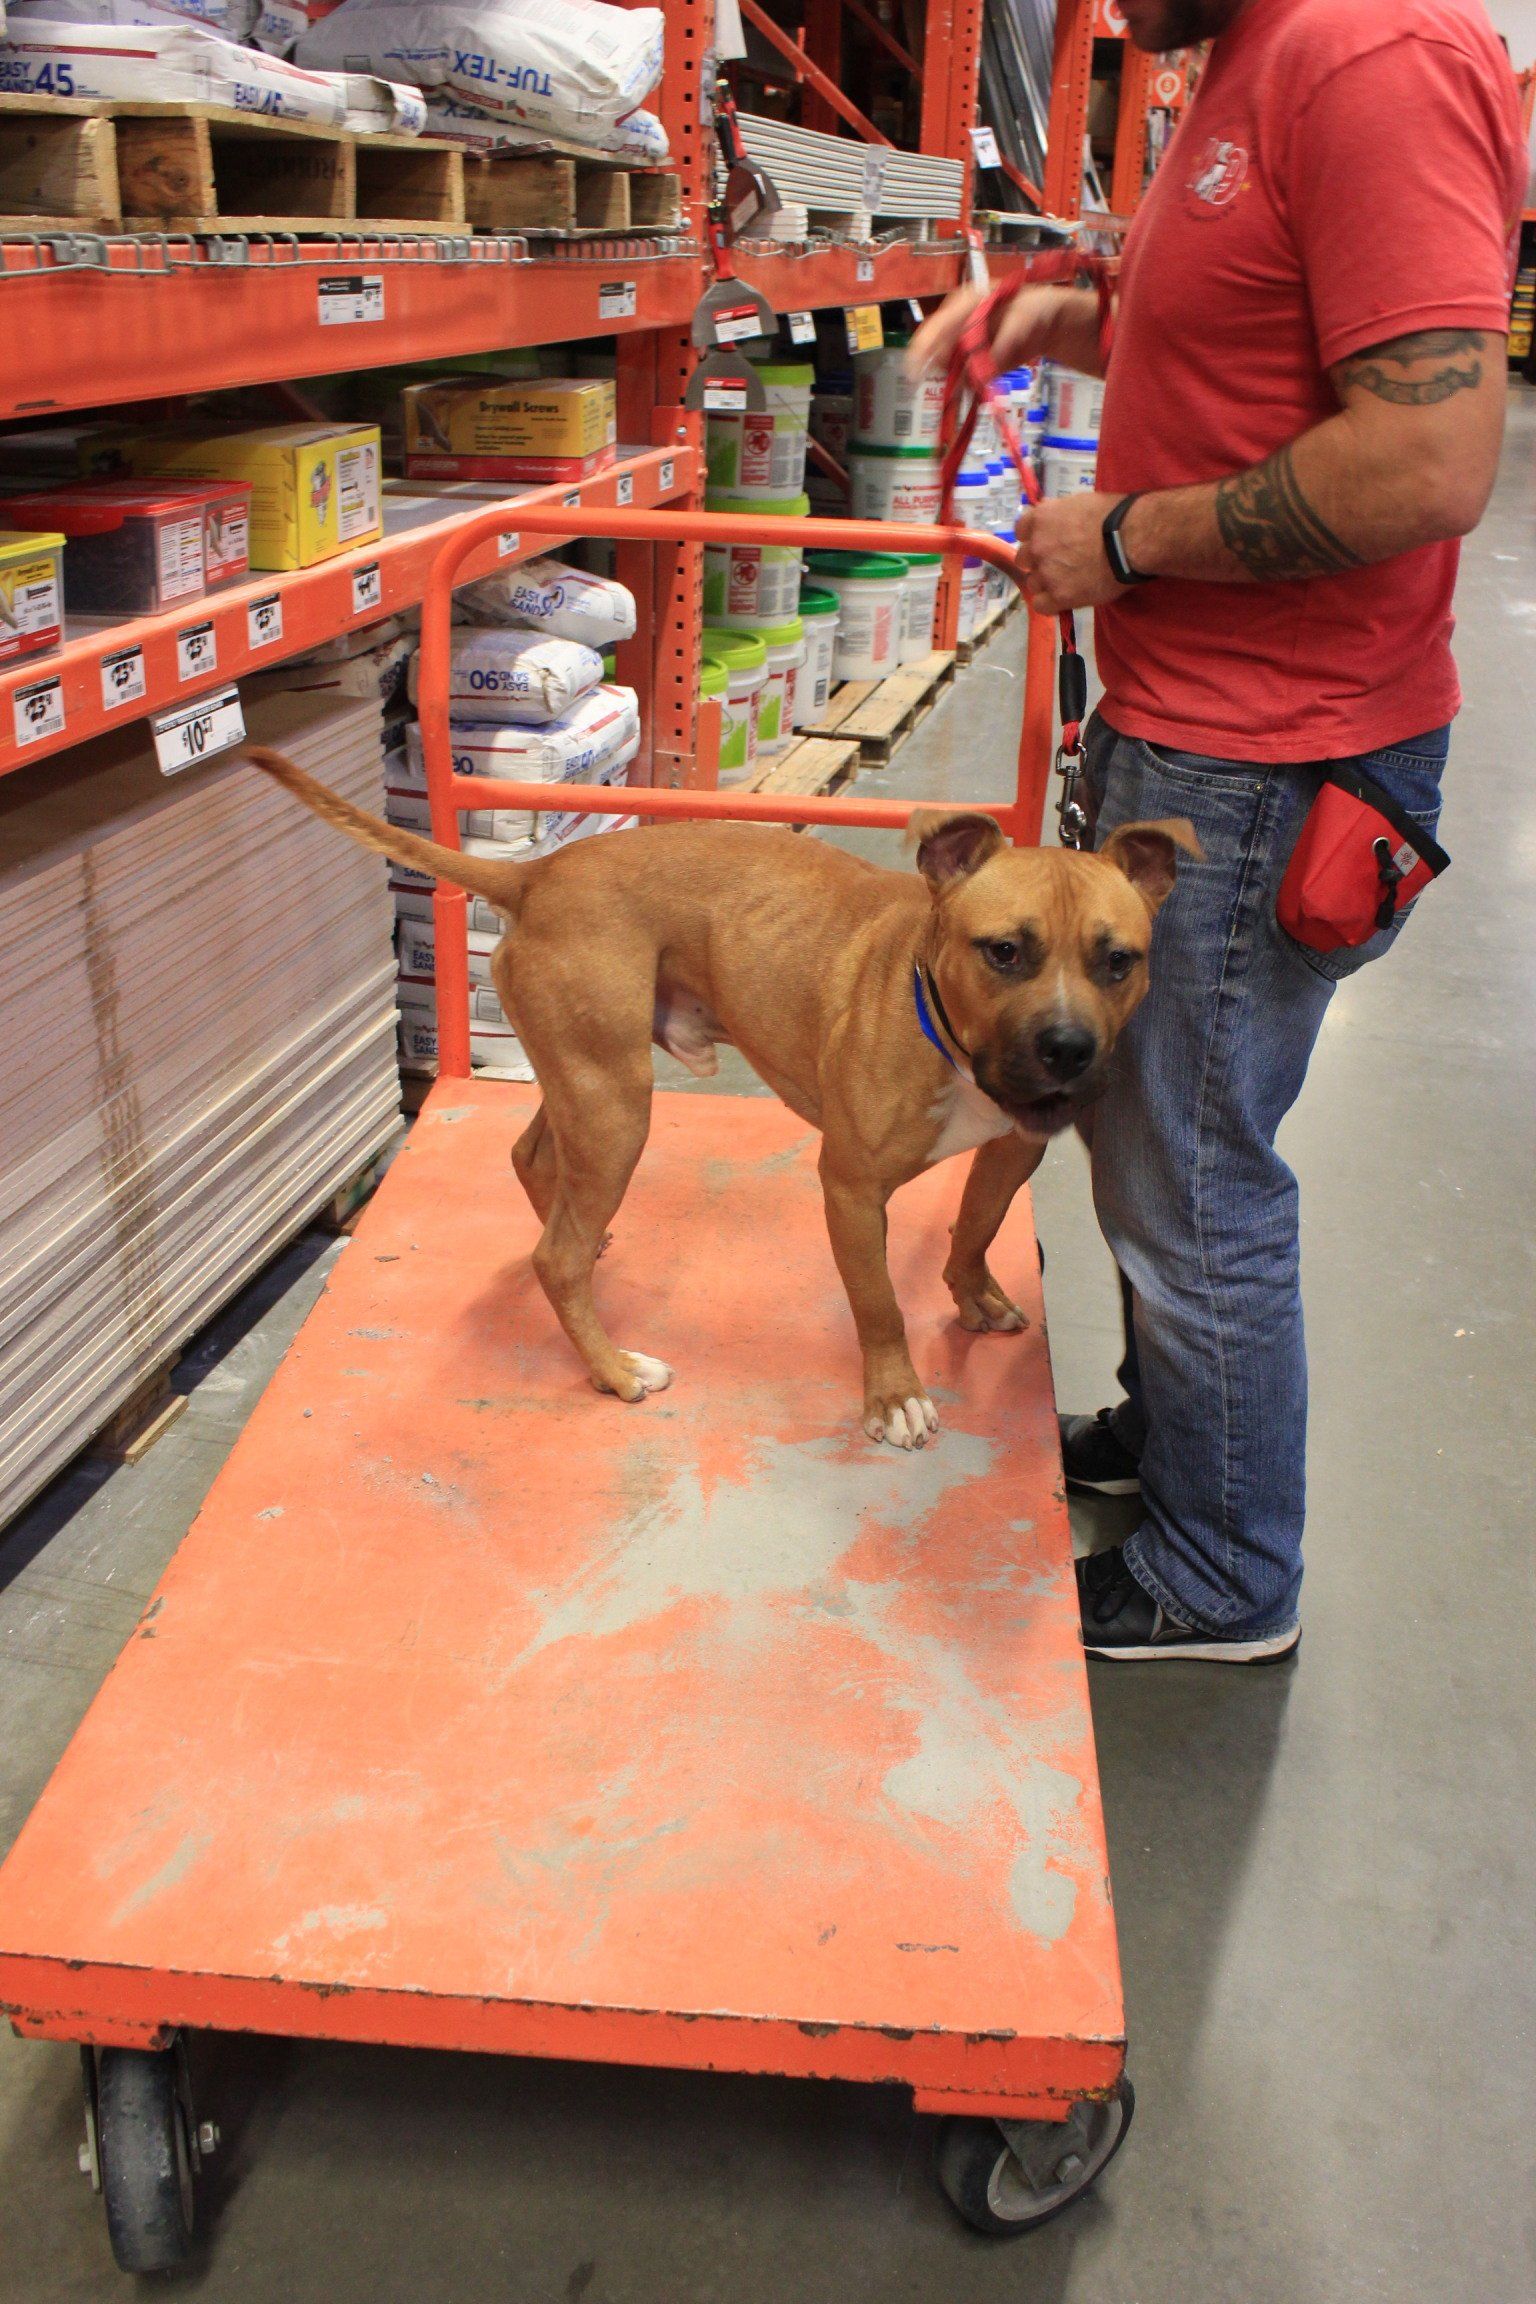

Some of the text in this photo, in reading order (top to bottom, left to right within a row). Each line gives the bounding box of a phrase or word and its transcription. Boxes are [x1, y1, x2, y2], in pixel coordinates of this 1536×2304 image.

[36, 62, 75, 96] 45
[452, 51, 553, 97] TUF-TEX
[479, 401, 559, 414] Drywall Screws
[513, 586, 540, 602] EASY
[510, 598, 542, 616] SAND
[469, 669, 530, 692] EASY 90
